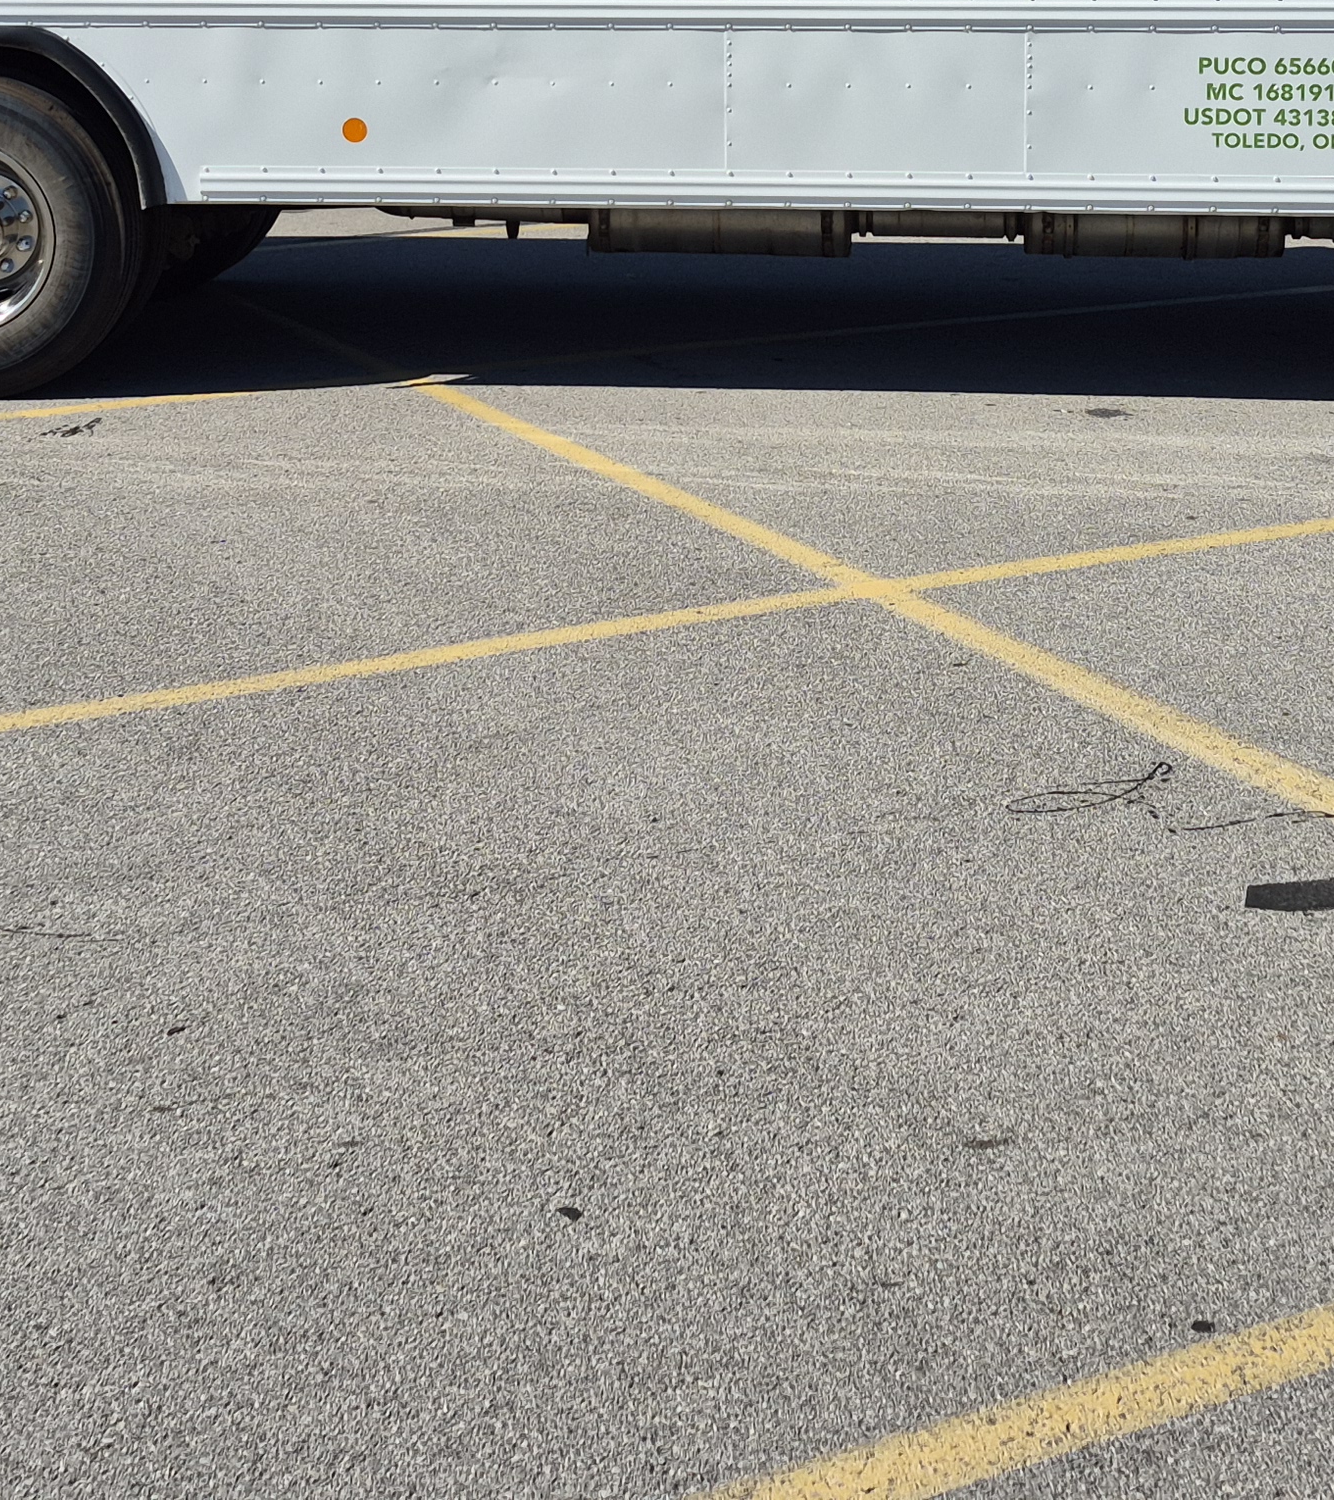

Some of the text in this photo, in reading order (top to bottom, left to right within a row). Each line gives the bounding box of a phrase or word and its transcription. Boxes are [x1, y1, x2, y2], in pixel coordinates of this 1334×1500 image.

[1198, 56, 1267, 76] PUCO
[1206, 82, 1244, 101] MC
[1183, 107, 1267, 126] USDOT
[1211, 132, 1305, 151] TOLEDO,
